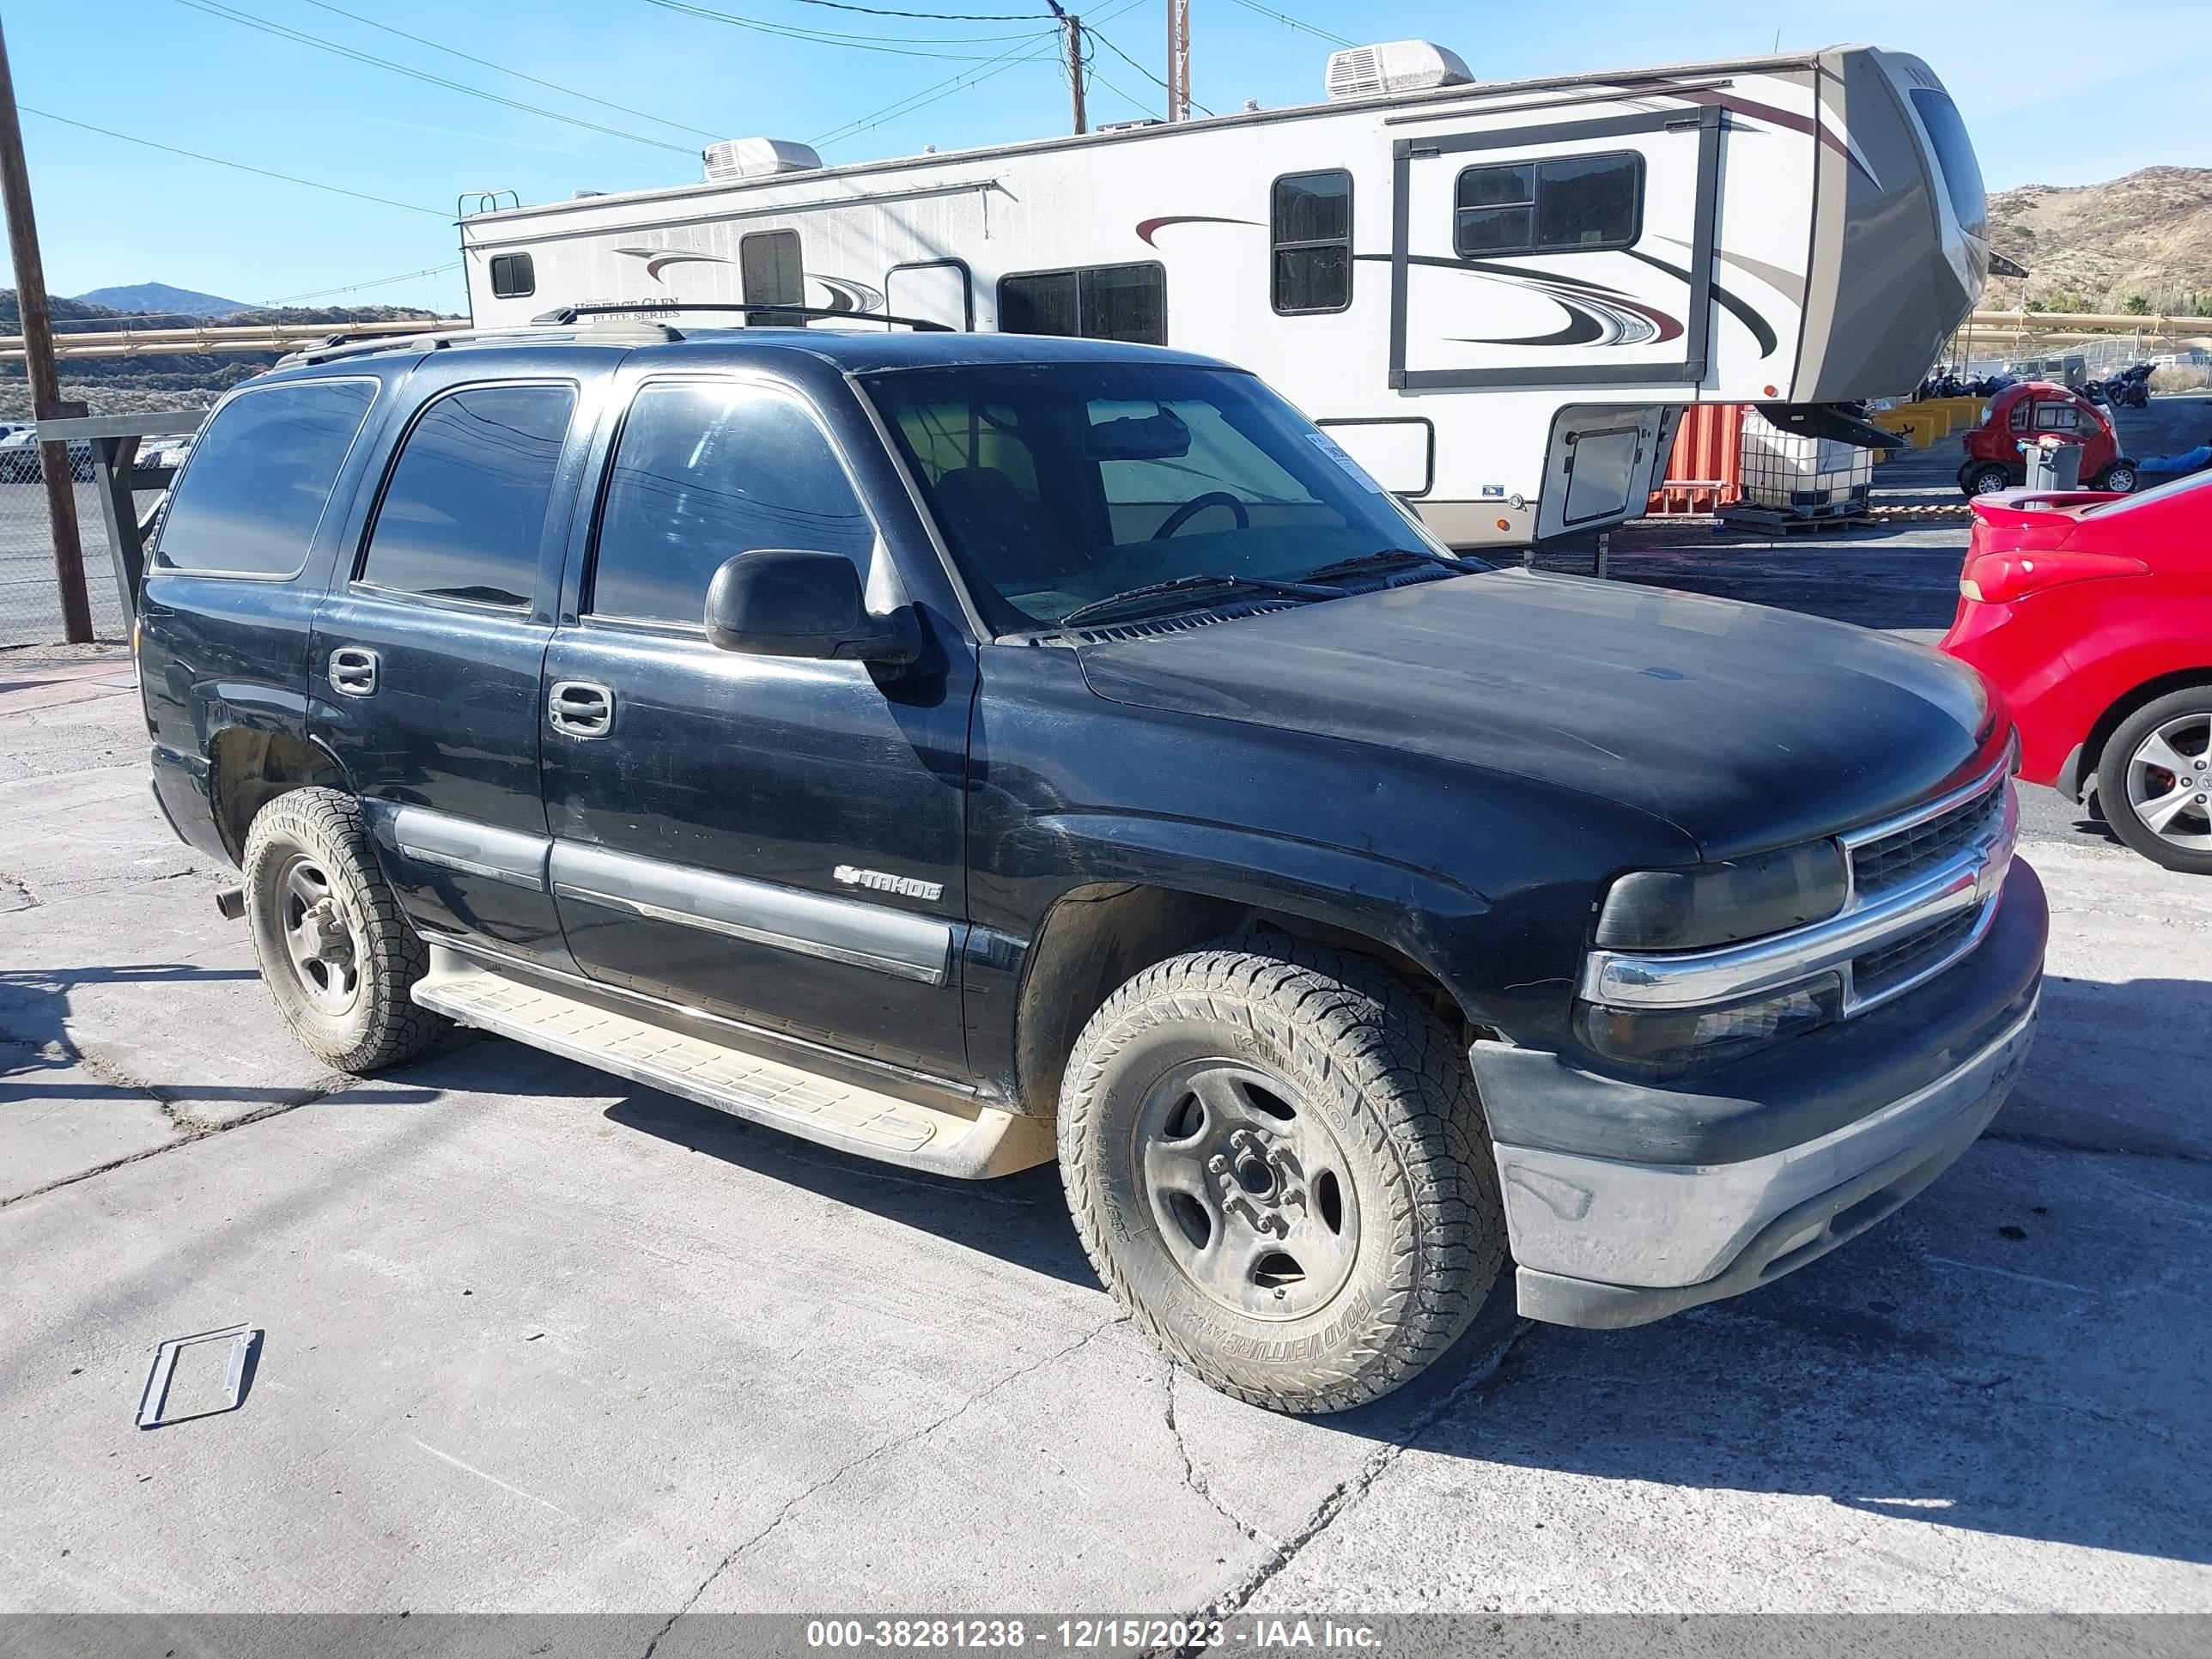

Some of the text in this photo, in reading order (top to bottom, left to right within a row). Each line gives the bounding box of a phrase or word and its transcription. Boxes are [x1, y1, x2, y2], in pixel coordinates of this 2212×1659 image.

[592, 310, 681, 324] ELITE SERIES
[861, 869, 944, 902] TAHOE
[1233, 1032, 1347, 1132] KUMHO
[1324, 1287, 1372, 1350] ROAD
[1221, 1332, 1326, 1363] VENTURE
